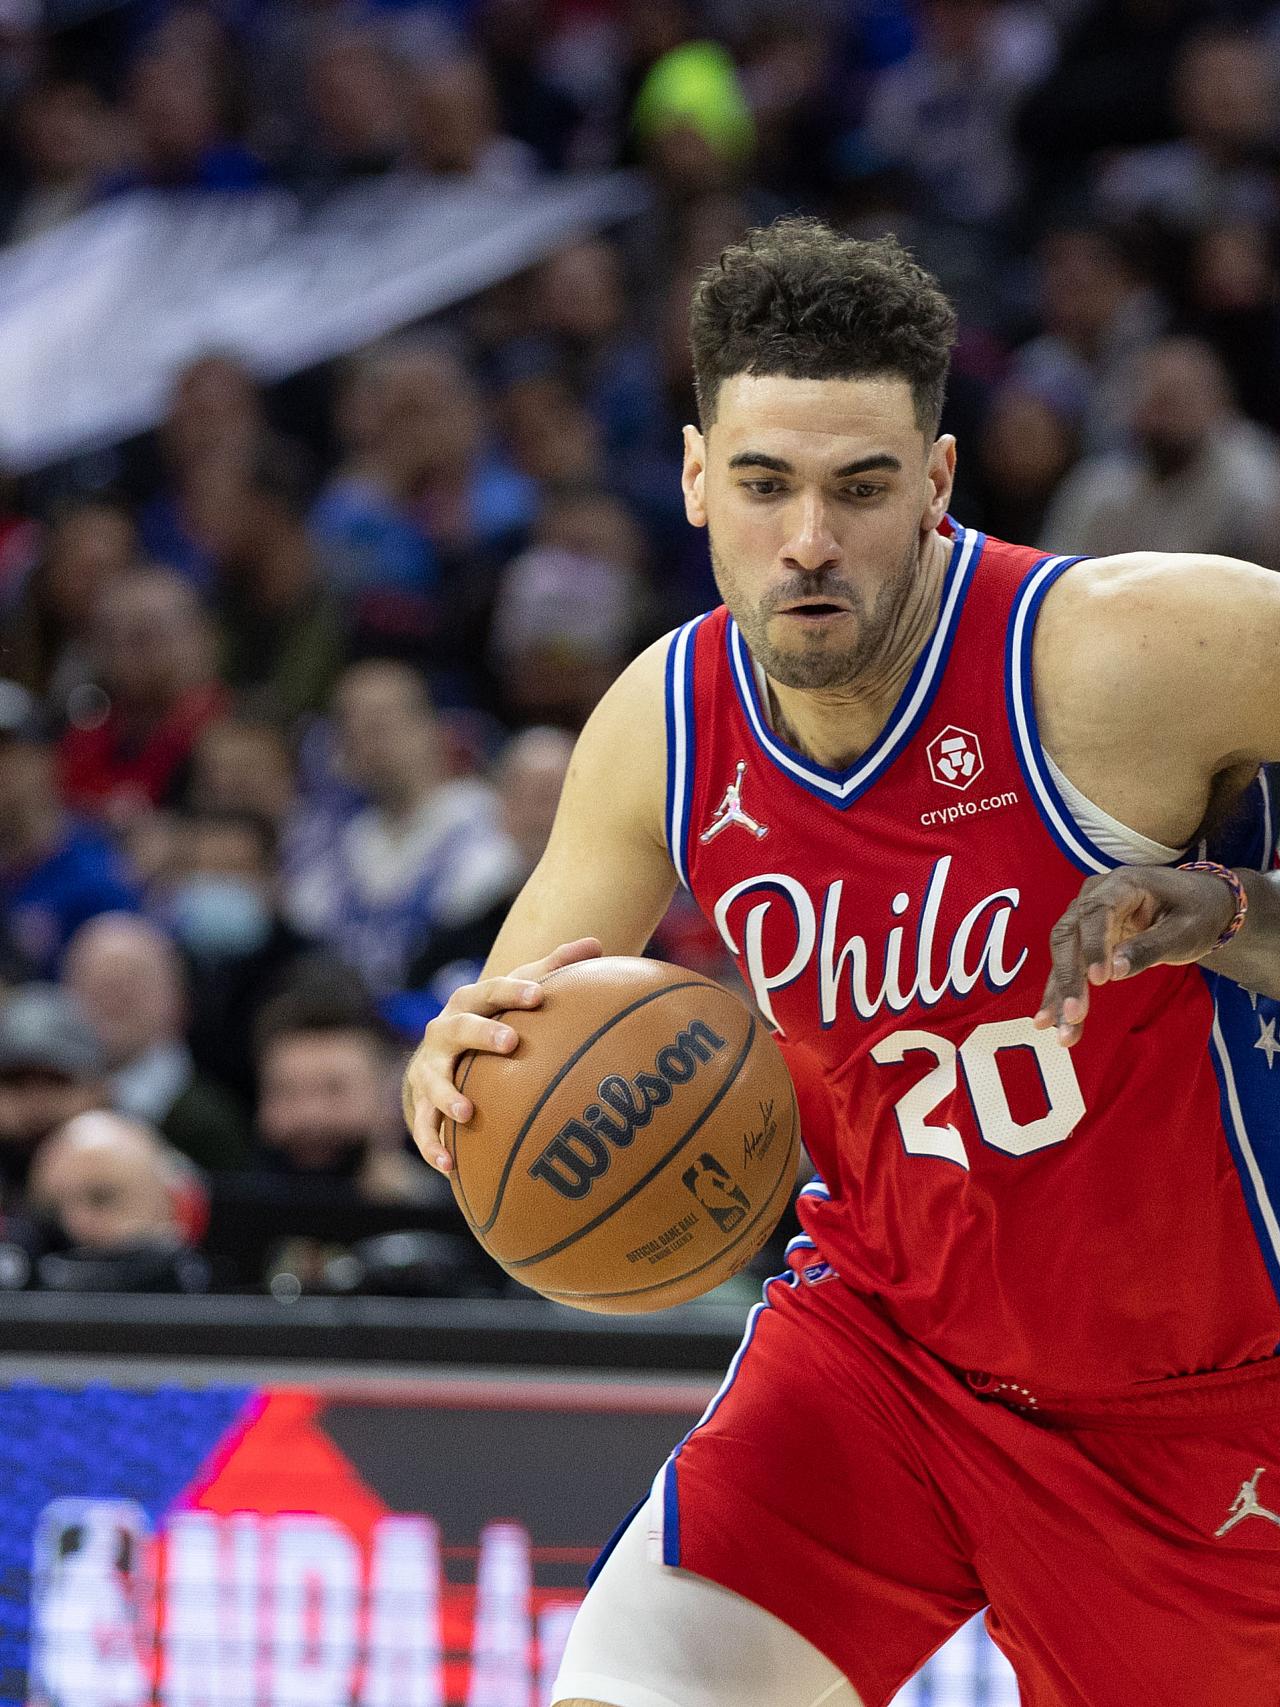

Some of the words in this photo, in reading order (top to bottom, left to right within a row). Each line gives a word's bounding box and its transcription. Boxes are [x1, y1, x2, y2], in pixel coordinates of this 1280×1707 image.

[920, 792, 1019, 826] crypto.com
[713, 855, 1029, 1037] Phila
[527, 1019, 729, 1200] Wilson
[870, 1016, 1087, 1172] 20
